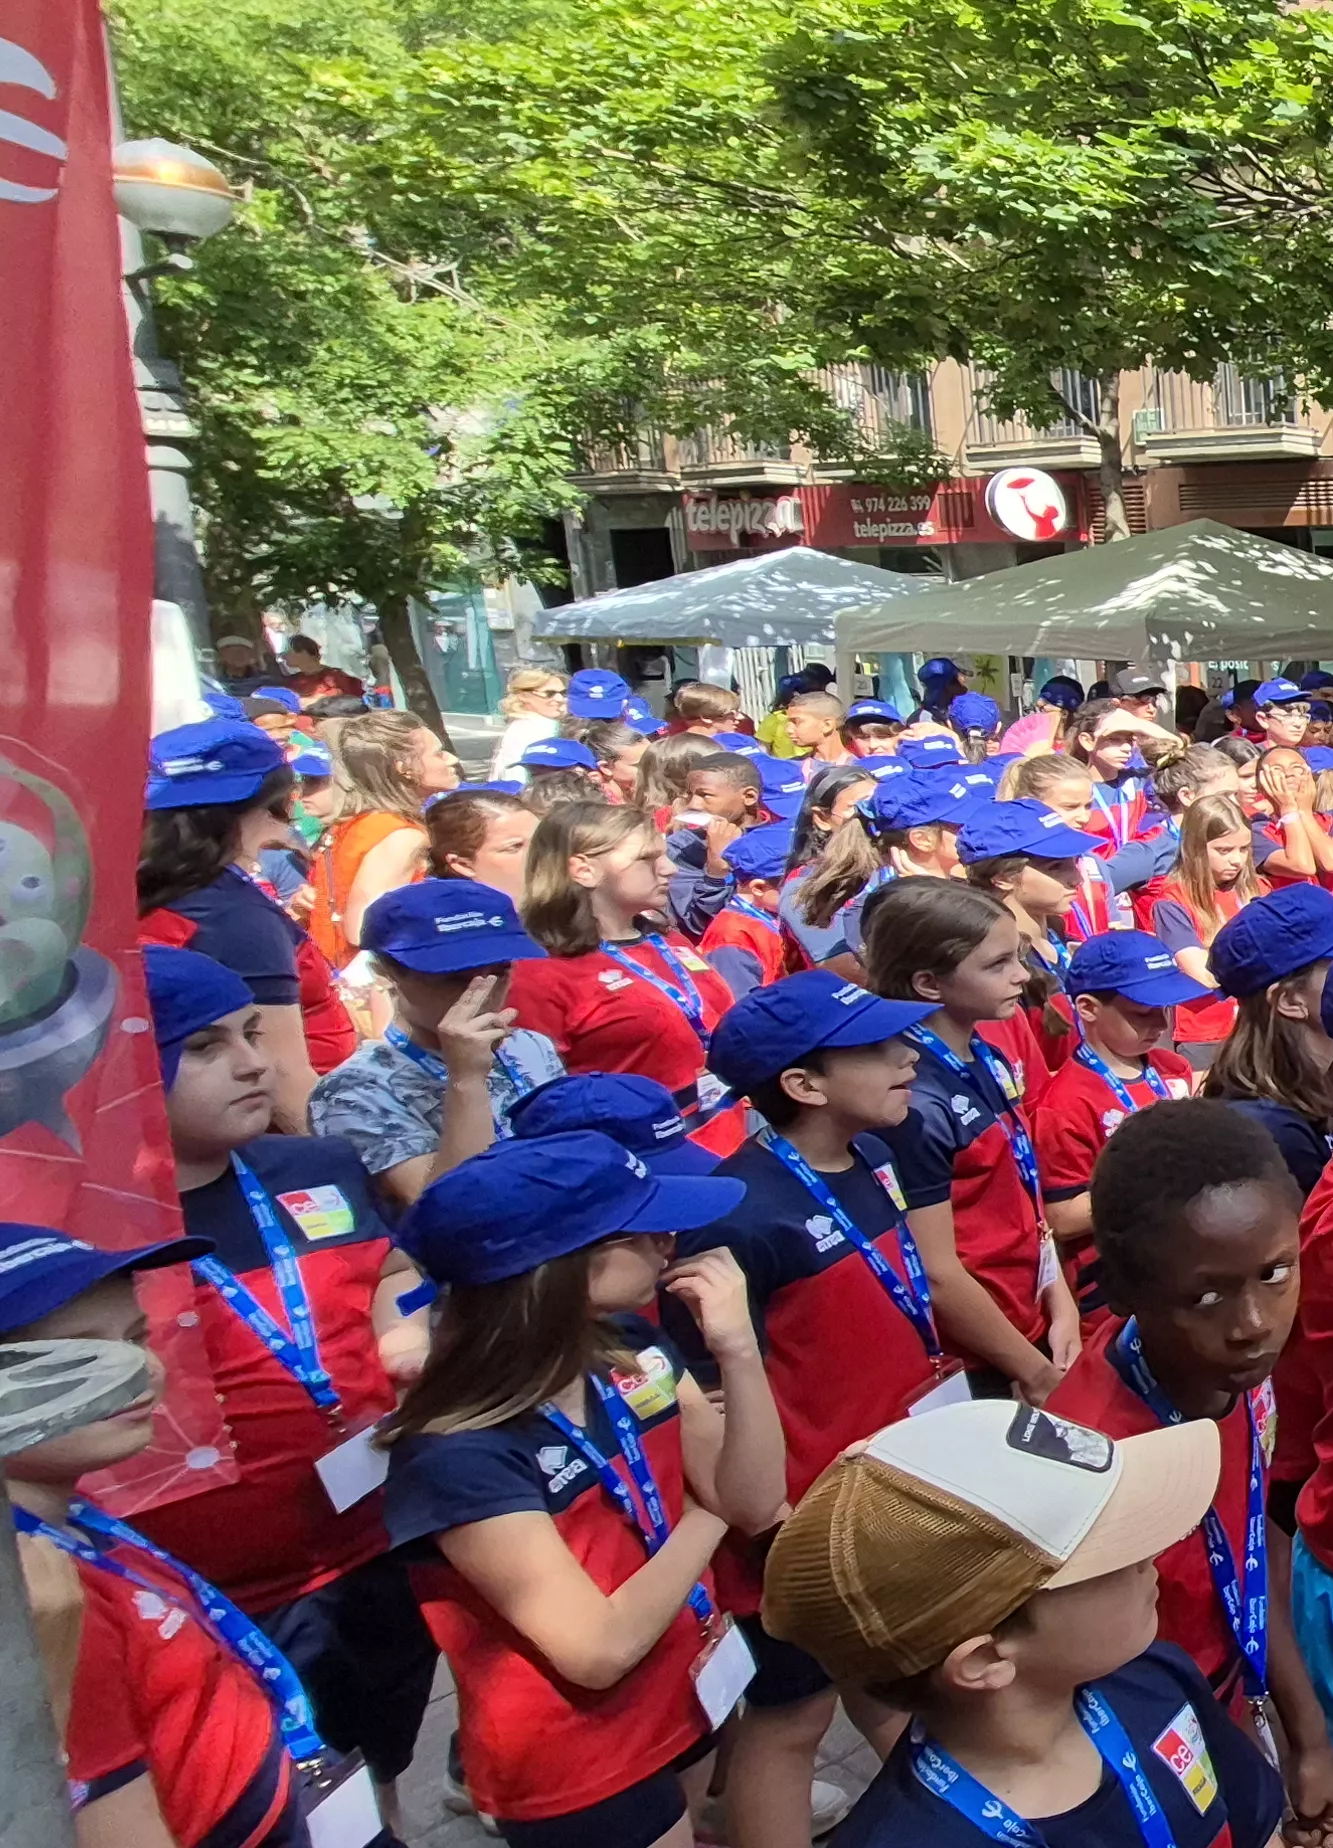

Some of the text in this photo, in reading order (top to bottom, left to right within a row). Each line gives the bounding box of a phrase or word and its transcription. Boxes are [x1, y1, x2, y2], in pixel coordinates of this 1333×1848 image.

[865, 495, 931, 513] 974 226 399
[853, 518, 936, 543] telepizza.es
